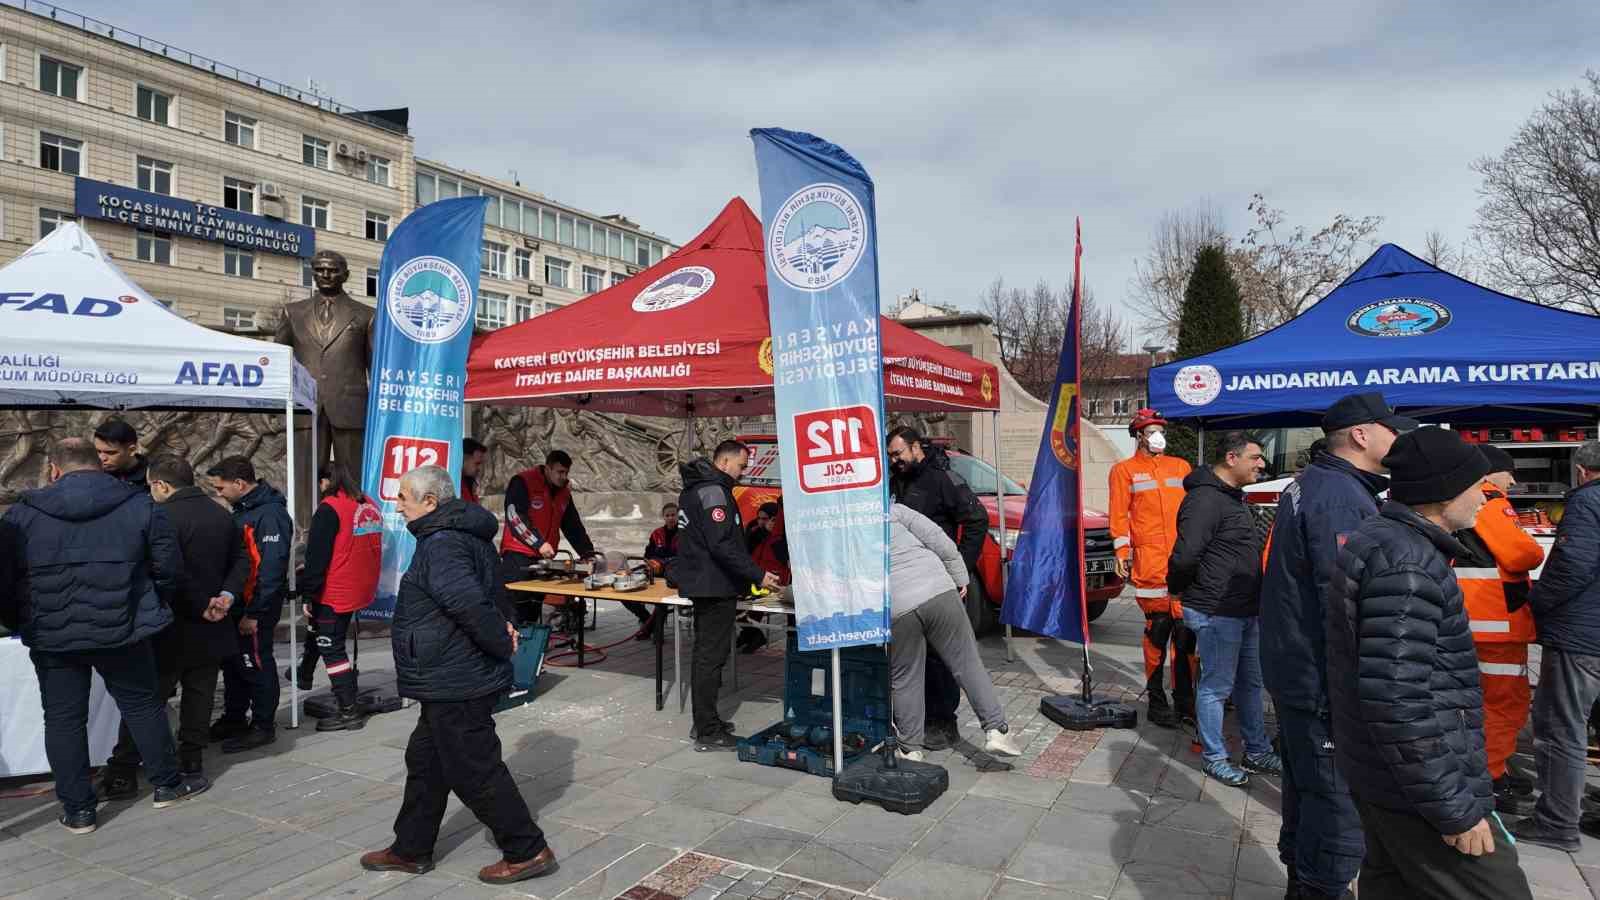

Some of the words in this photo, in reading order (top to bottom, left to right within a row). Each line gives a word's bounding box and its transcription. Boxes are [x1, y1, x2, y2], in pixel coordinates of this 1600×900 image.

[98, 194, 192, 222] KOCASİNAN
[197, 214, 301, 244] KAYMAKAMLIĞI
[195, 203, 221, 218] T.C.
[101, 206, 140, 223] İLÇE
[145, 214, 211, 238] EMNİYET
[215, 226, 300, 253] MÜDÜRLÜĞÜ
[0, 354, 60, 368] ALİLİĞİ
[494, 351, 547, 371] KAYSERİ
[550, 343, 635, 366] BÜYÜKŞEHİR
[638, 338, 721, 359] BELEDİYESİ
[34, 369, 139, 385] MÜDÜRLÜĞÜ
[175, 360, 265, 387] AFAD
[515, 370, 562, 388] İTFAİYE
[564, 367, 604, 384] DAİRE
[606, 362, 692, 382] BAŞKANLIĞI
[1225, 370, 1358, 391] JANDARMA
[1364, 366, 1460, 385] ARAMA
